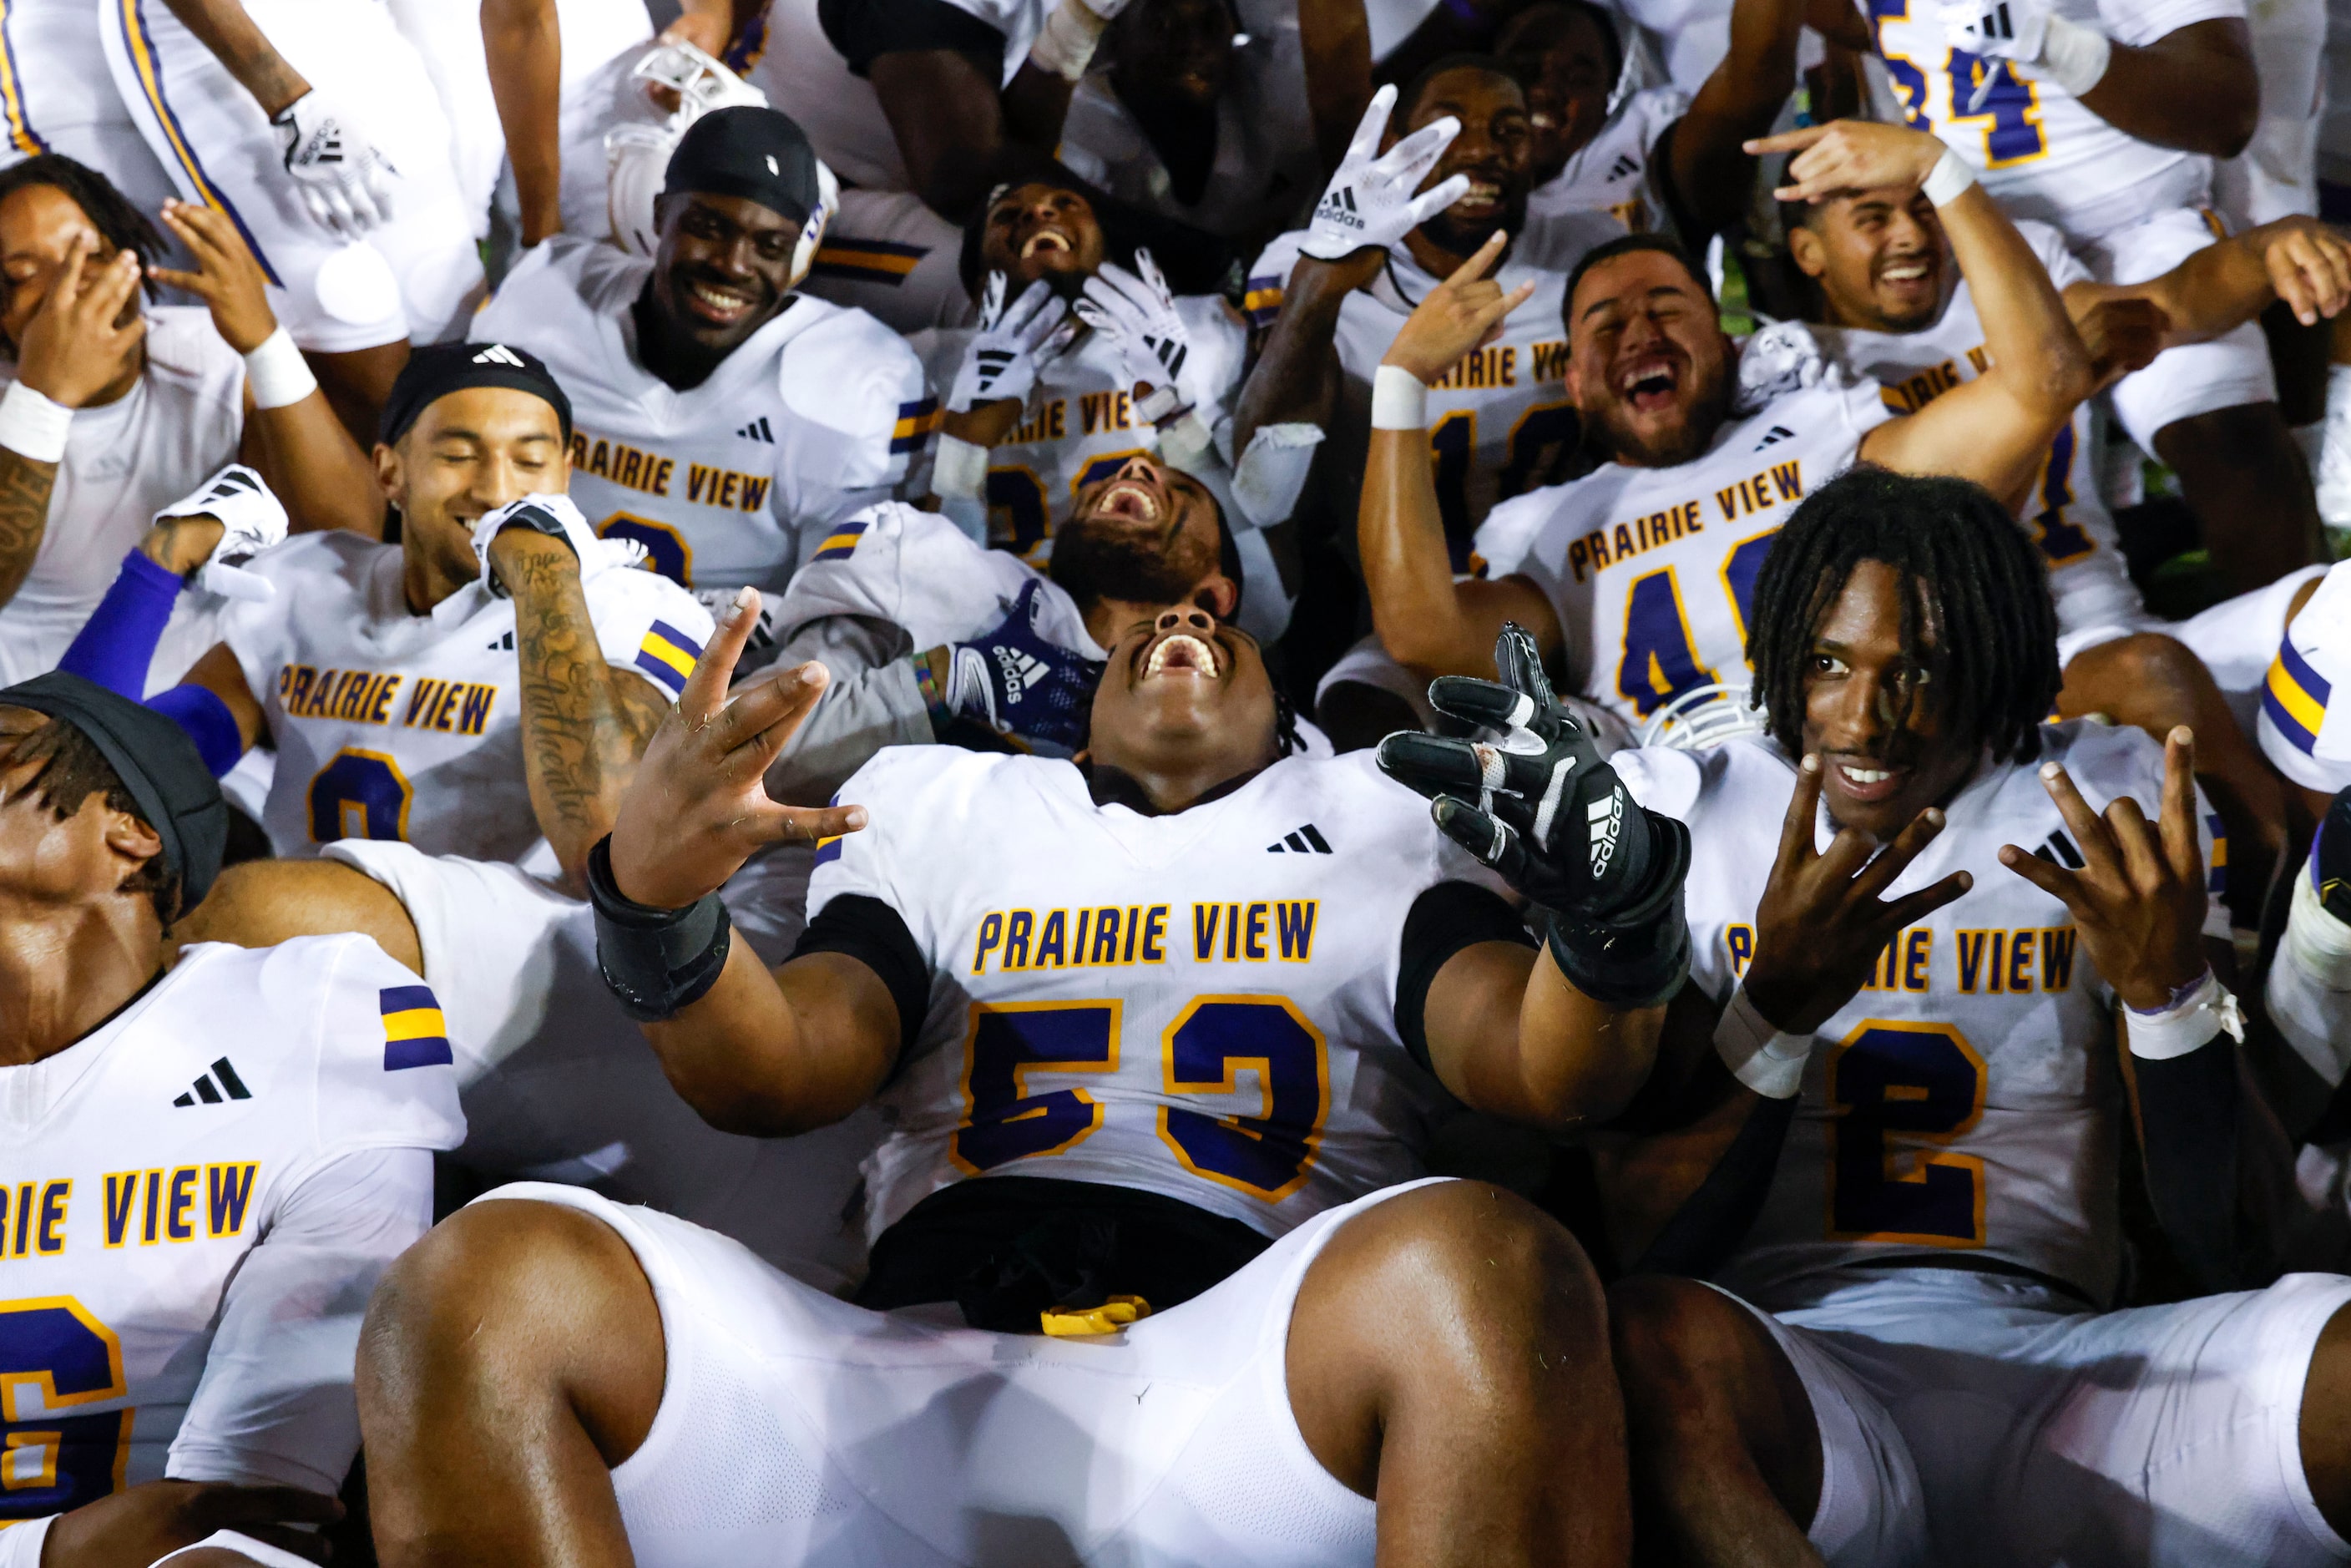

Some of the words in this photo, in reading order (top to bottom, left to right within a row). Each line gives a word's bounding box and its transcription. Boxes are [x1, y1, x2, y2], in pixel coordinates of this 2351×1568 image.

[1079, 390, 1154, 436] VIE
[571, 429, 675, 498] RAIRIE
[685, 462, 772, 513] VIEW
[1567, 500, 1705, 584] PRAIRIE
[1713, 458, 1803, 524] VIEW
[279, 664, 402, 726] PRAIRIE
[403, 677, 498, 736] VIEW
[992, 645, 1022, 705] adidas
[1593, 785, 1623, 879] adidas
[971, 903, 1170, 975] PRAIRIE
[1191, 899, 1320, 964] VIEW
[1954, 923, 2078, 995] VIEW
[948, 994, 1331, 1205] 53
[1824, 1017, 1989, 1251] 2
[102, 1161, 261, 1249] VIEW
